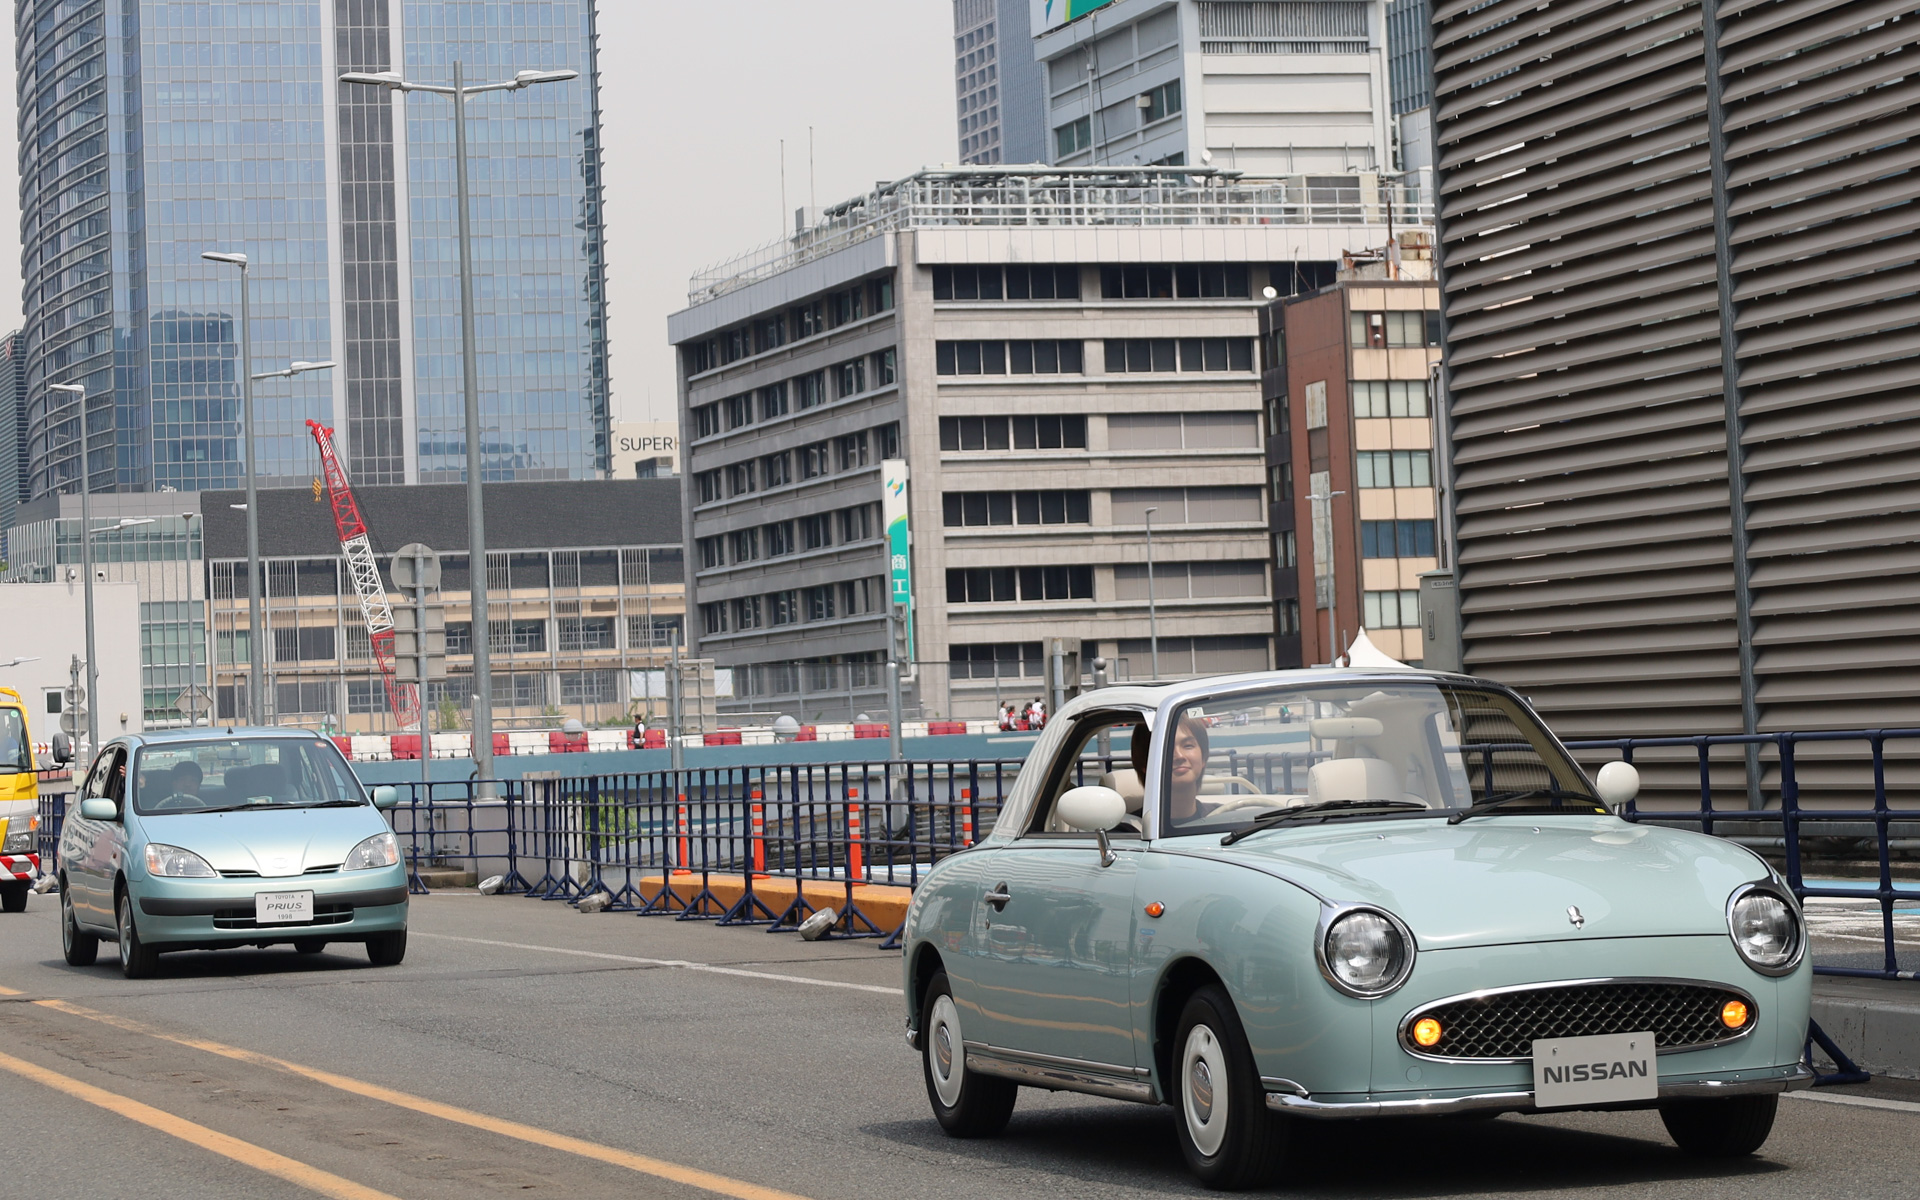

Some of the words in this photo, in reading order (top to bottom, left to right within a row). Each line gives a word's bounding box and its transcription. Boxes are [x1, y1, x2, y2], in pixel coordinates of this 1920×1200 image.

[891, 554, 908, 594] 商工
[266, 902, 303, 911] PRIUS
[1543, 1059, 1648, 1085] NISSAN
